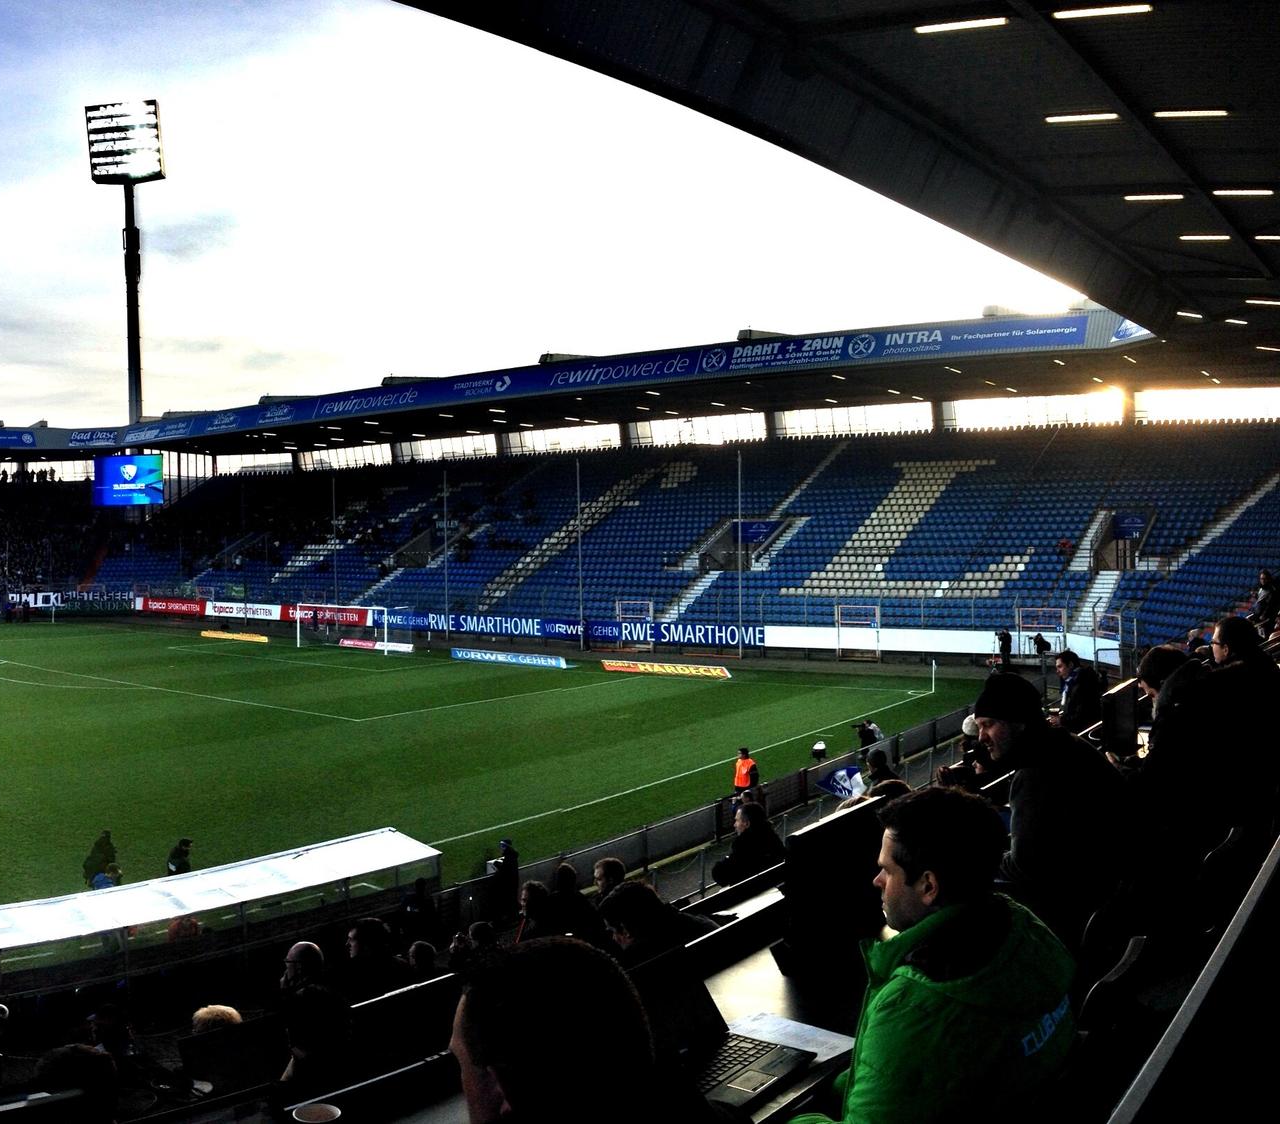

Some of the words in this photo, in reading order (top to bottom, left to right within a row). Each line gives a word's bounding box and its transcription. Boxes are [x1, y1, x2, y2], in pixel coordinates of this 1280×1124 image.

[885, 330, 942, 344] INTRA
[950, 334, 961, 342] Ihr
[963, 330, 1010, 342] Fachpartner
[1011, 328, 1024, 338] für
[1026, 326, 1077, 337] Solarenergie
[732, 342, 782, 358] DRAHT
[803, 336, 844, 350] ZAUN
[817, 348, 841, 357] GmbH
[882, 344, 941, 356] photovoltaics
[550, 355, 689, 386] rewirpower.de
[453, 378, 493, 391] STADTWERKE
[321, 388, 417, 414] rewirpower.de
[71, 431, 90, 440] Bad
[148, 600, 166, 610] tipico
[167, 602, 201, 612] SPORTWETTEN
[213, 604, 234, 615] tipico
[235, 606, 273, 617] SPORTWETTEN
[408, 615, 429, 627] GEHEN
[430, 613, 456, 631] RWE
[459, 614, 542, 636] SMARTHOME
[544, 622, 584, 635] VORWE
[592, 625, 619, 637] GEHEN
[622, 622, 655, 642] RWE
[661, 623, 764, 645] SMARTHOME
[456, 649, 516, 662] VORWEG
[518, 654, 557, 666] GEHEN
[638, 663, 724, 676] HARDECK
